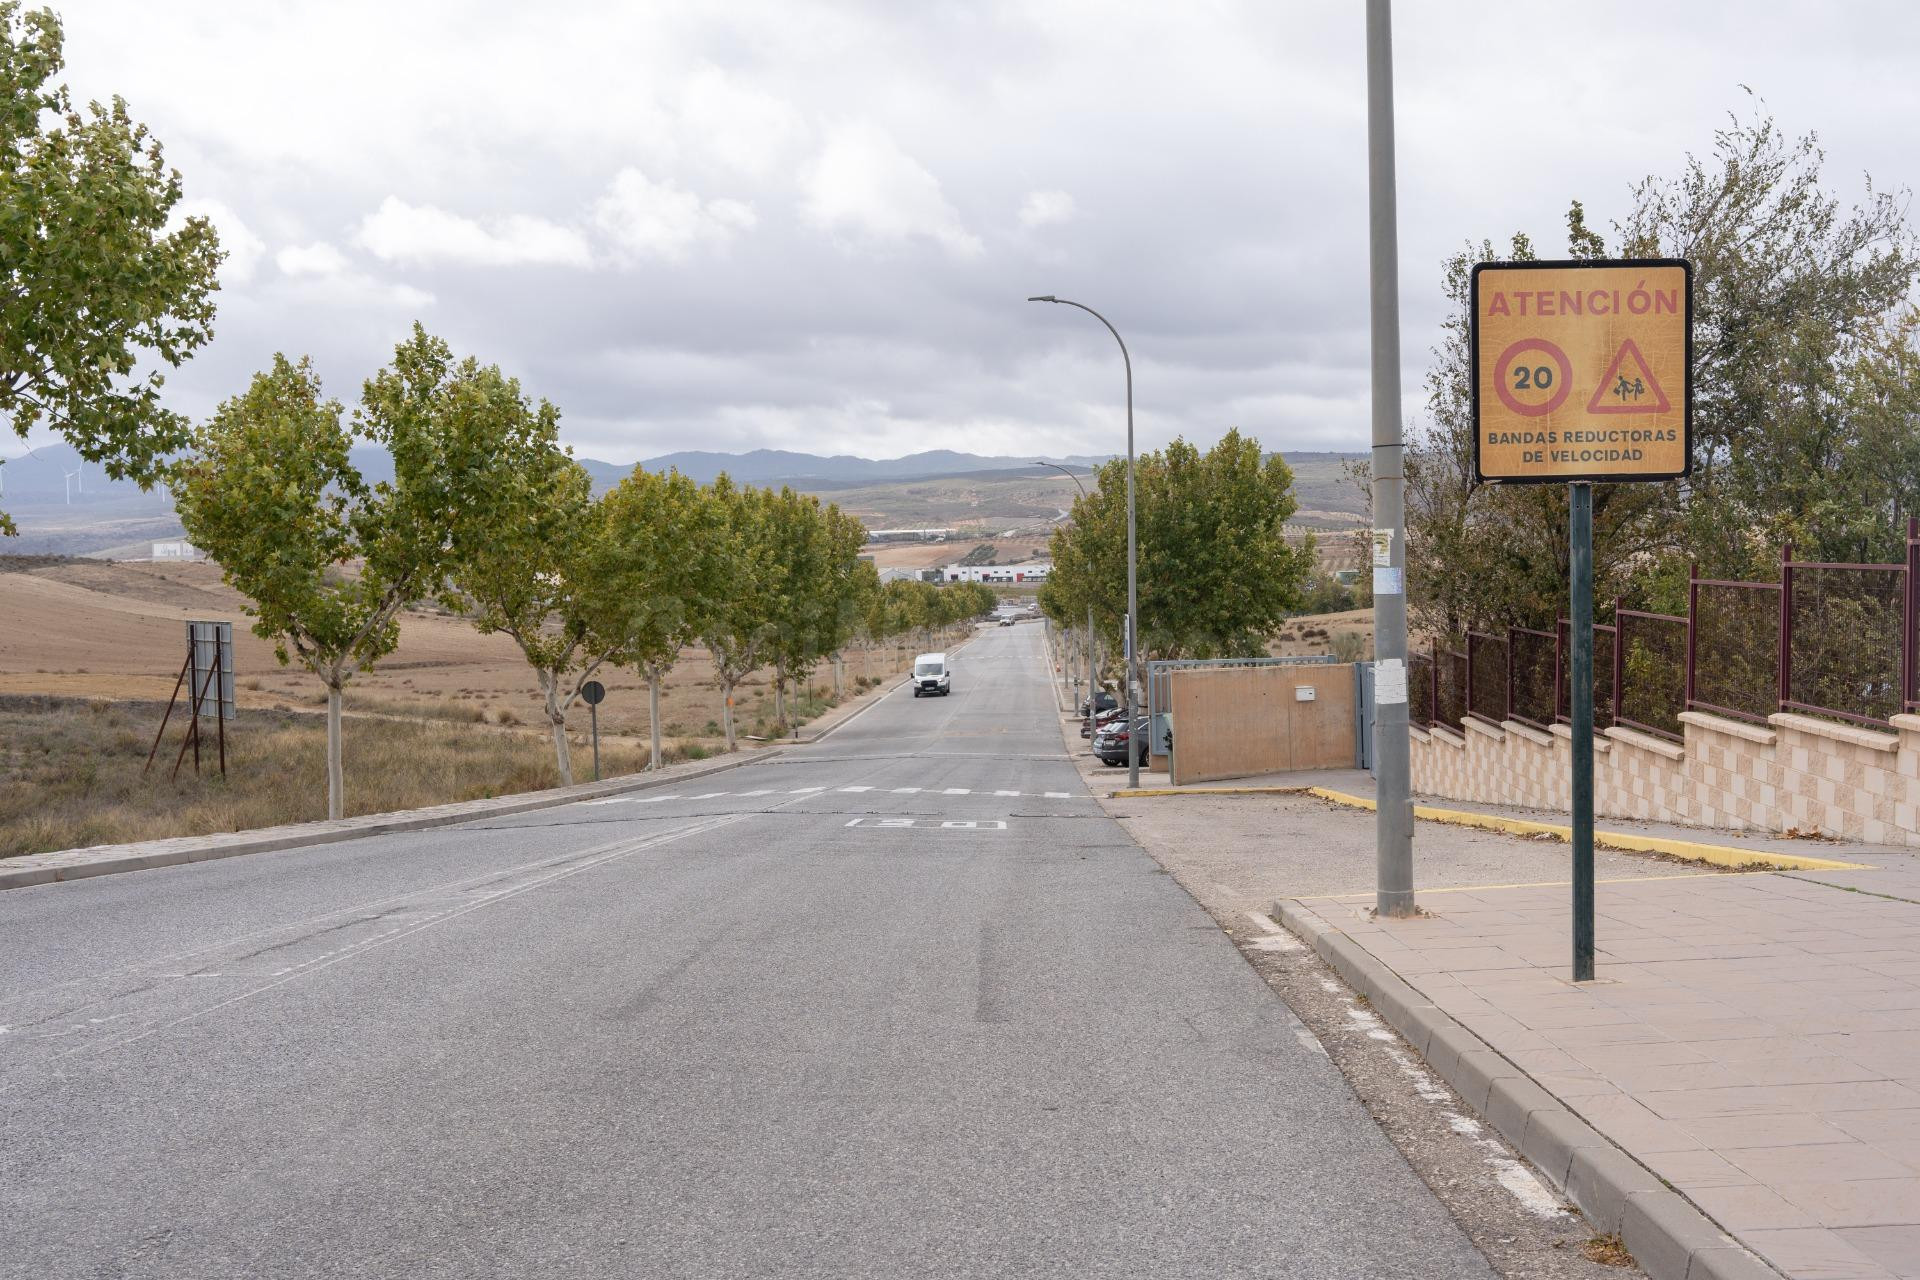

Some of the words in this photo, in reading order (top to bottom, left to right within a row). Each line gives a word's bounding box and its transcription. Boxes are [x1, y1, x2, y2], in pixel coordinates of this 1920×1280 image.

[1487, 279, 1678, 317] ATENCIÓN
[1513, 366, 1553, 390] 20
[1488, 431, 1557, 445] BANDAS
[1563, 429, 1677, 443] REDUCTORAS
[1522, 450, 1544, 463] DE
[1551, 449, 1643, 462] VELOCIDAD
